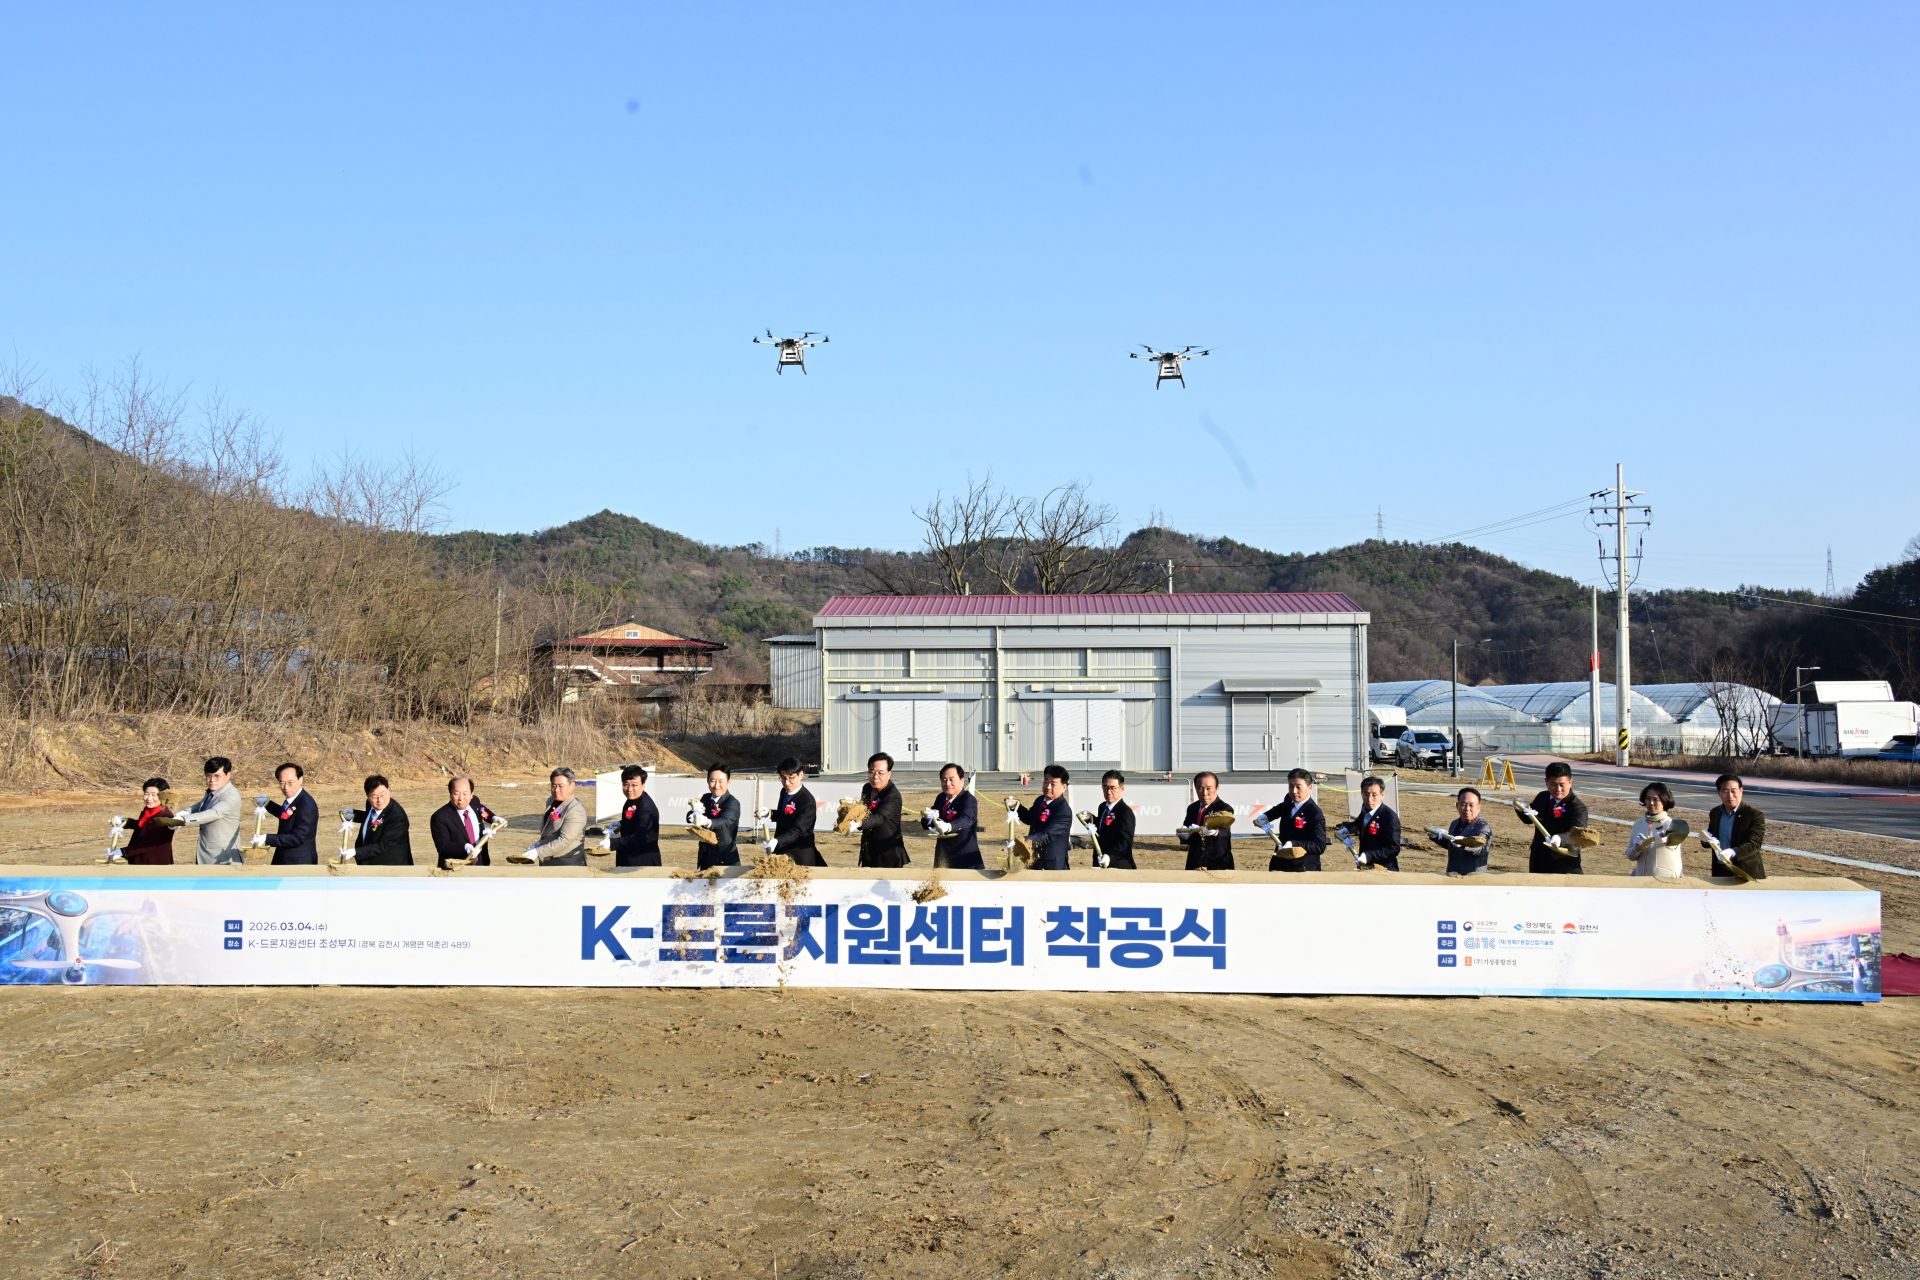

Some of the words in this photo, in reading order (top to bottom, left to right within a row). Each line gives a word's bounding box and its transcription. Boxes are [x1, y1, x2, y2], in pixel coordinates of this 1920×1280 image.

[249, 922, 328, 932] 2026.03.04.(수)
[580, 903, 1025, 966] K-드론지원센터
[1043, 906, 1227, 970] 착공식
[248, 939, 316, 949] K-드론지원센터
[319, 939, 356, 949] 조성부지
